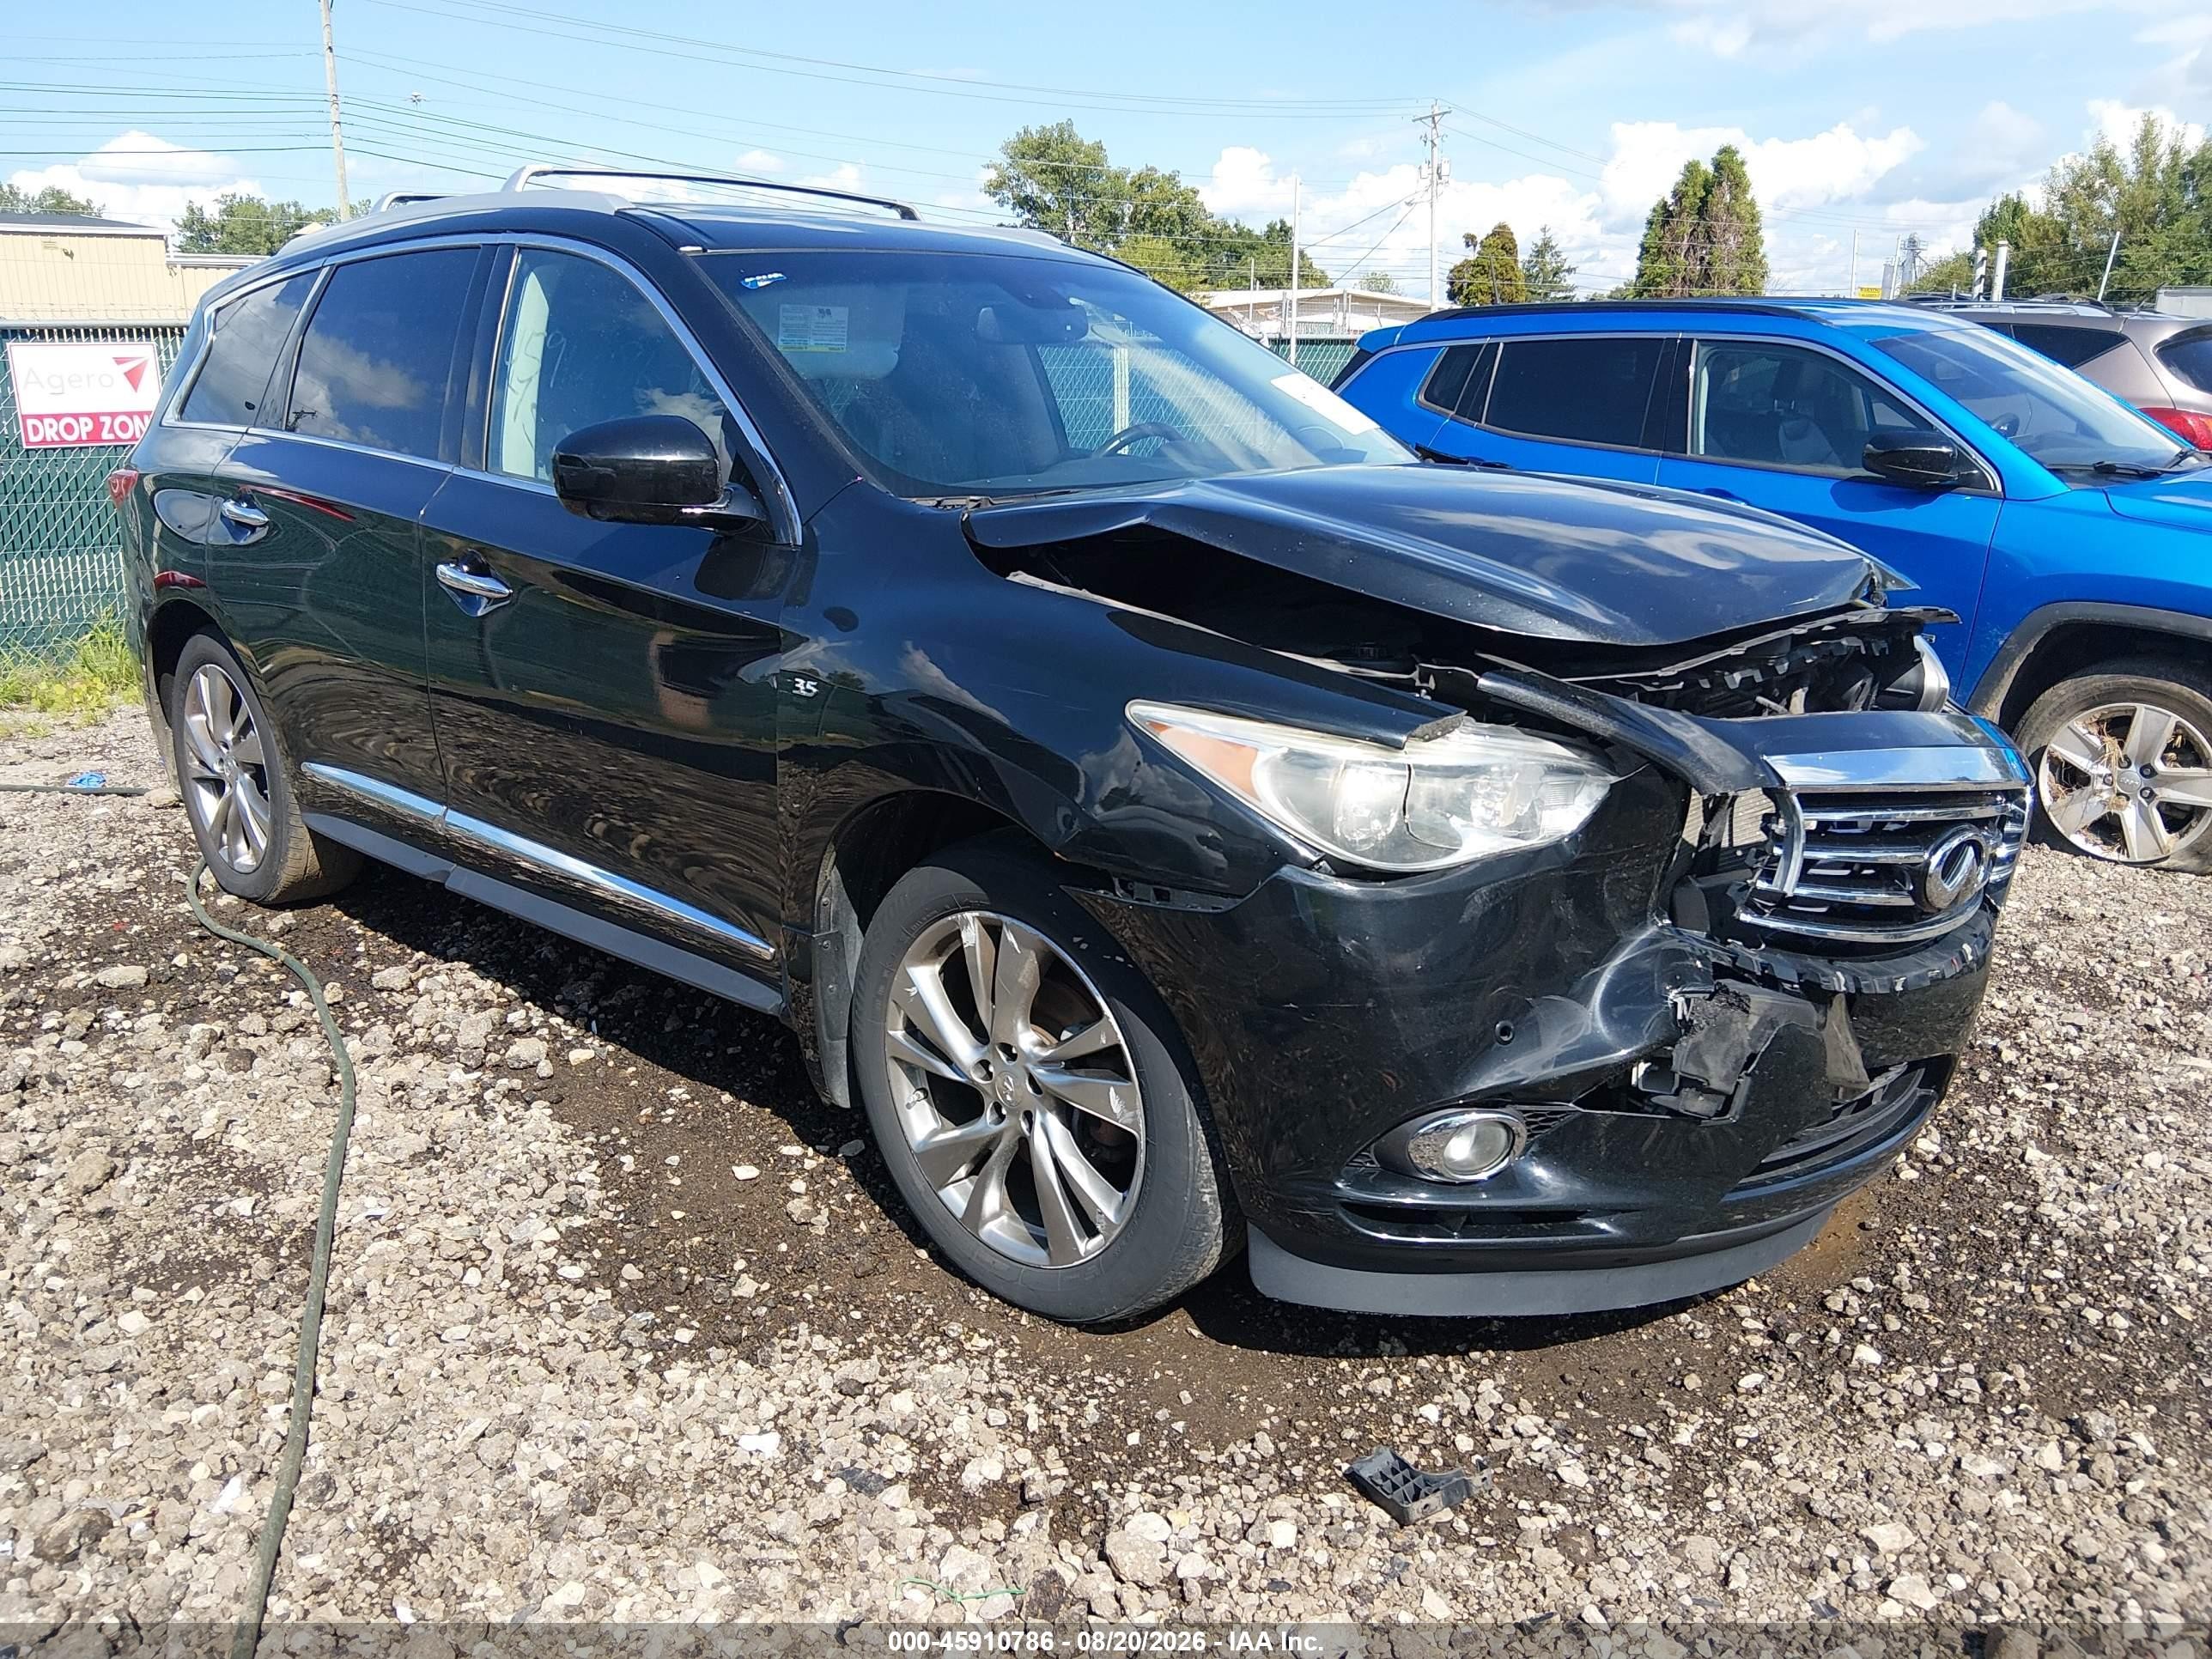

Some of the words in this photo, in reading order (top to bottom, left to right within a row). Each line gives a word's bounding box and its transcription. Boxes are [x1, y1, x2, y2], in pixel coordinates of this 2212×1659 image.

[23, 367, 114, 395] Agero
[26, 416, 94, 443] DROP
[100, 414, 152, 440] ZON
